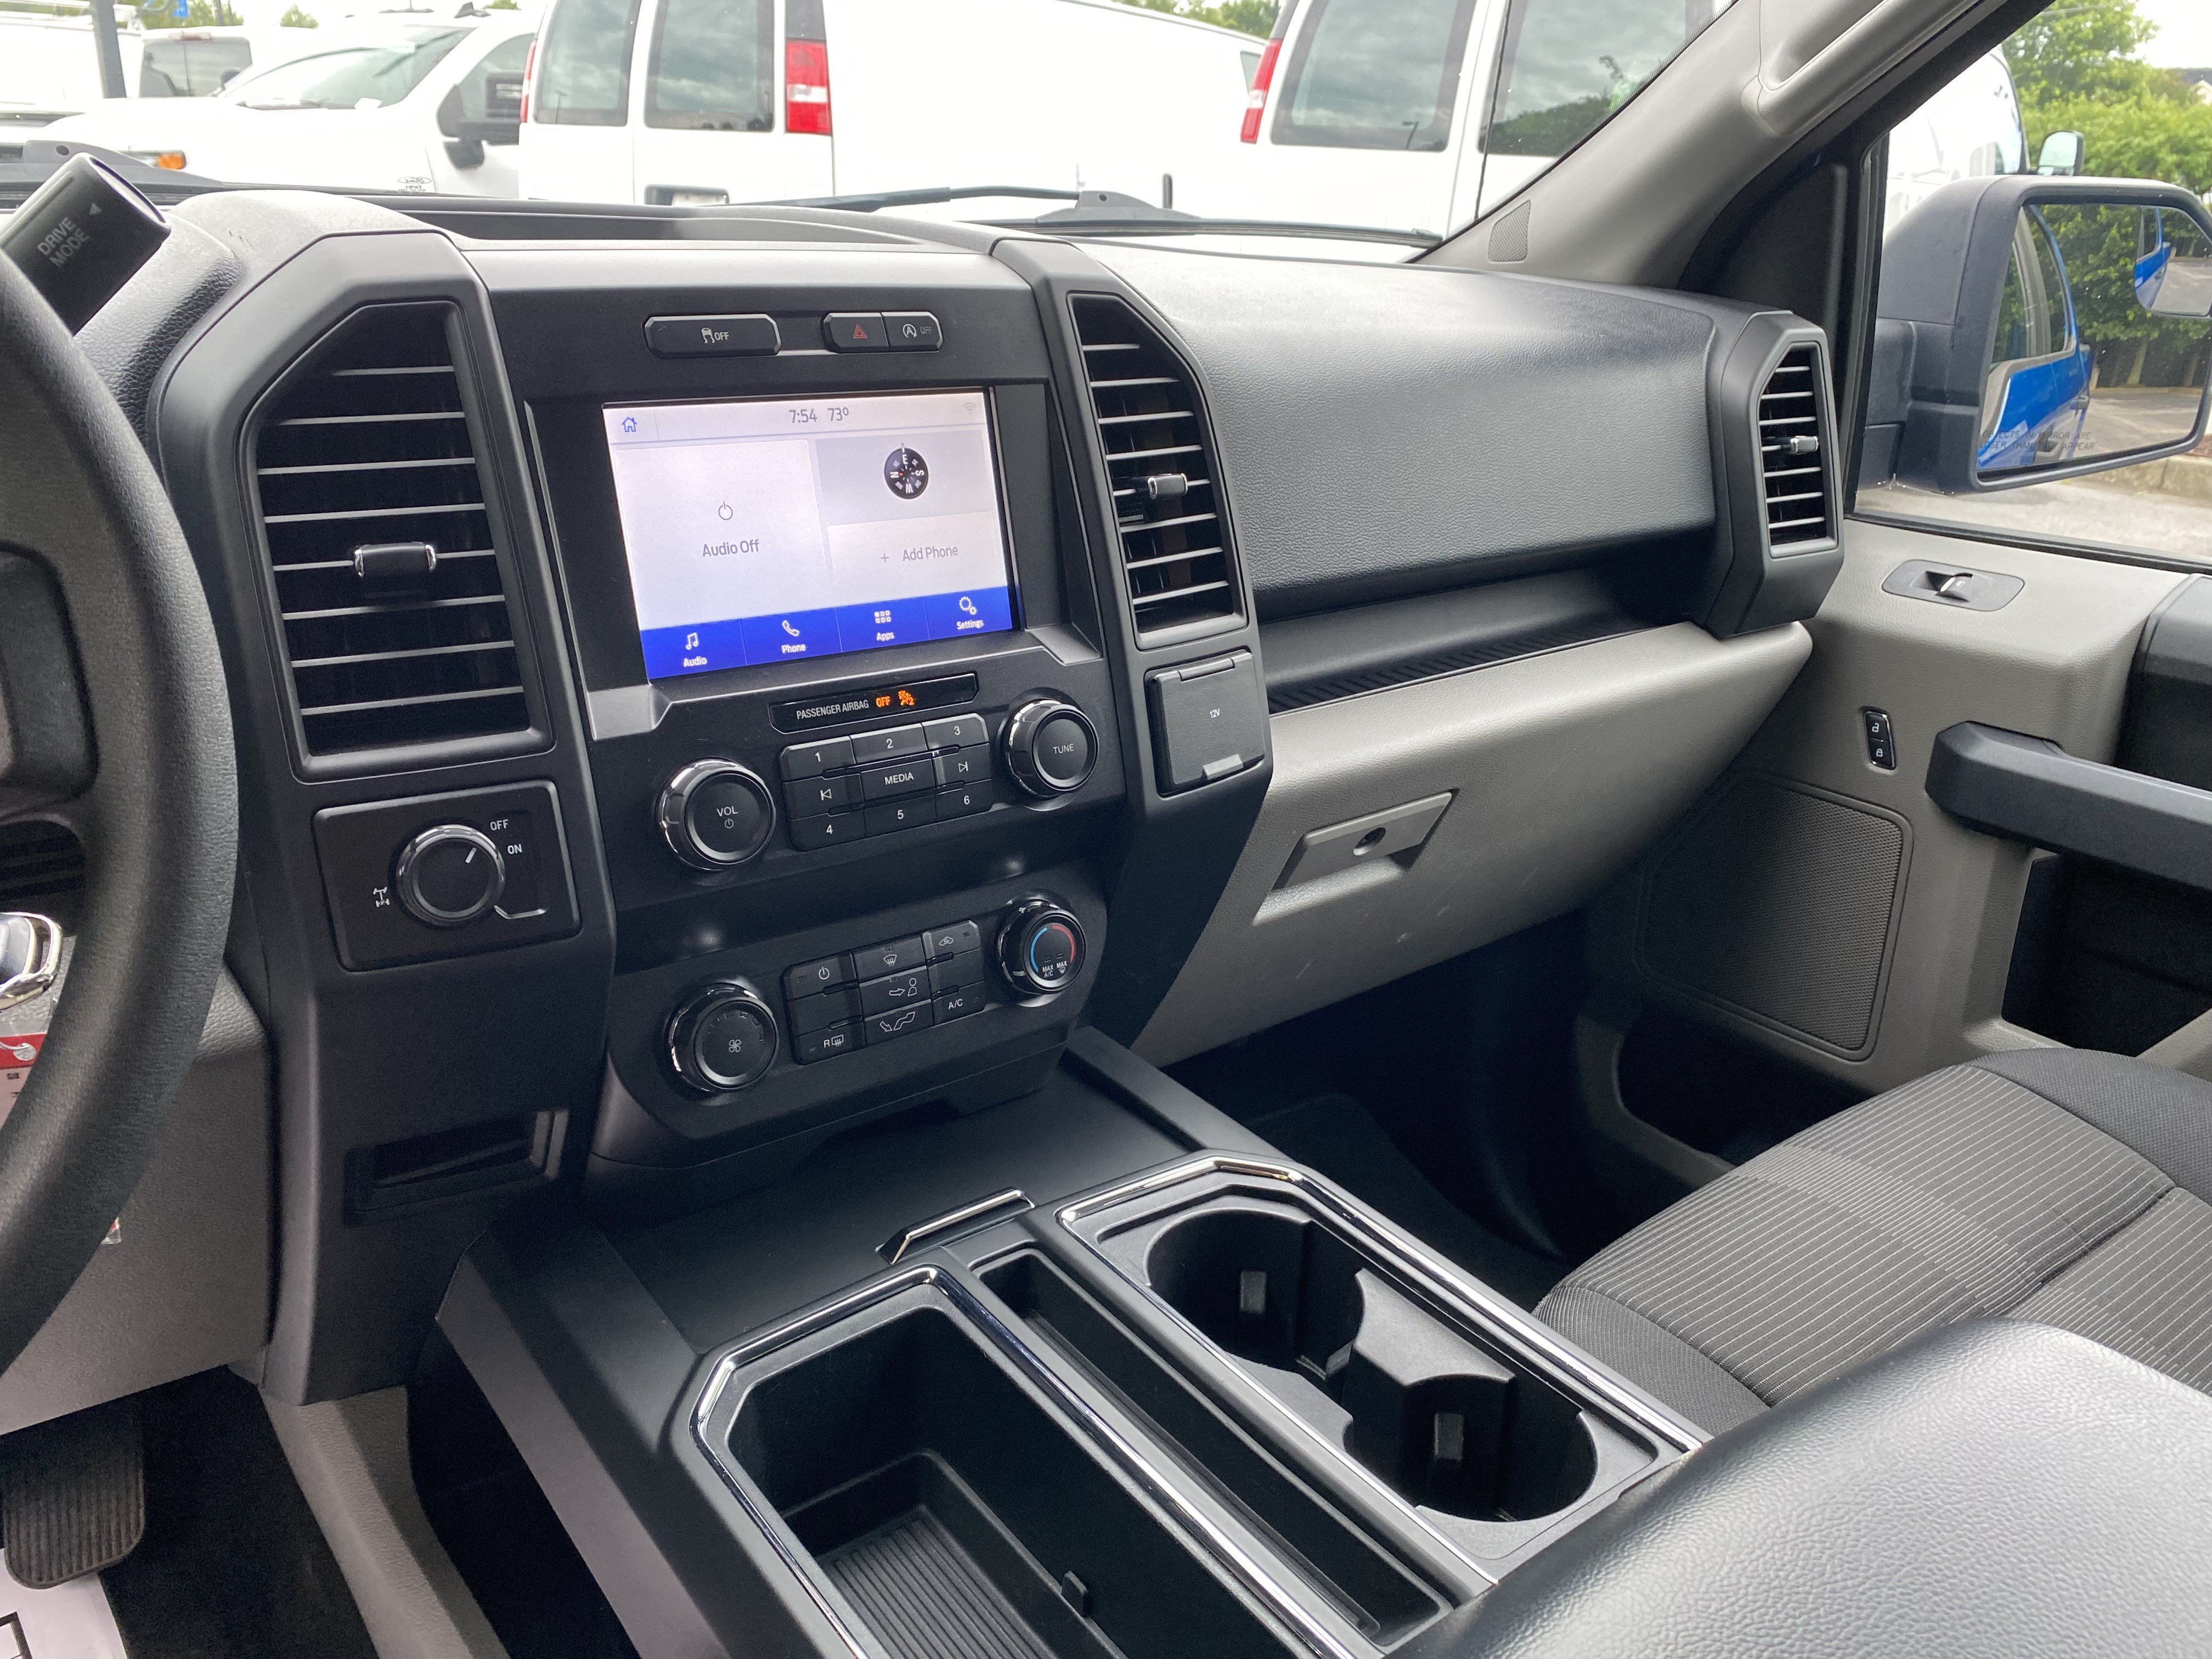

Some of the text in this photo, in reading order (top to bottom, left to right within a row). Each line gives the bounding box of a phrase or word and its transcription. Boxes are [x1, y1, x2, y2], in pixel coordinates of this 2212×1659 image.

[38, 218, 76, 255] DRIVE
[49, 229, 90, 267] MODE
[714, 331, 729, 341] OFF
[788, 408, 817, 423] 7:54
[2075, 432, 2092, 440] ARE
[2062, 442, 2095, 451] APPEAR
[902, 454, 908, 465] E
[905, 483, 913, 493] W
[702, 539, 760, 557] Audio Off
[902, 546, 958, 561] Add Phone
[956, 619, 984, 630] Settings
[876, 632, 895, 642] Apps
[781, 644, 806, 654] Phone
[683, 656, 708, 667] Audio
[796, 704, 844, 720] PASSENGER
[842, 699, 869, 712] AIRBAG
[876, 695, 891, 708] OFF
[1209, 708, 1220, 719] 12V
[953, 726, 961, 736] 3
[885, 738, 894, 749] 2
[1052, 743, 1075, 755] TUNE
[815, 752, 822, 763] 1
[884, 771, 915, 786] MEDIA
[963, 795, 970, 805] 6
[716, 805, 739, 817] VOL
[897, 810, 904, 820] 5
[489, 819, 509, 831] OFF
[826, 824, 833, 835] 4
[507, 844, 522, 855] ON
[1042, 964, 1054, 973] MAX
[1056, 961, 1068, 969] MAX
[948, 998, 963, 1010] A/C
[823, 1039, 831, 1048] R
